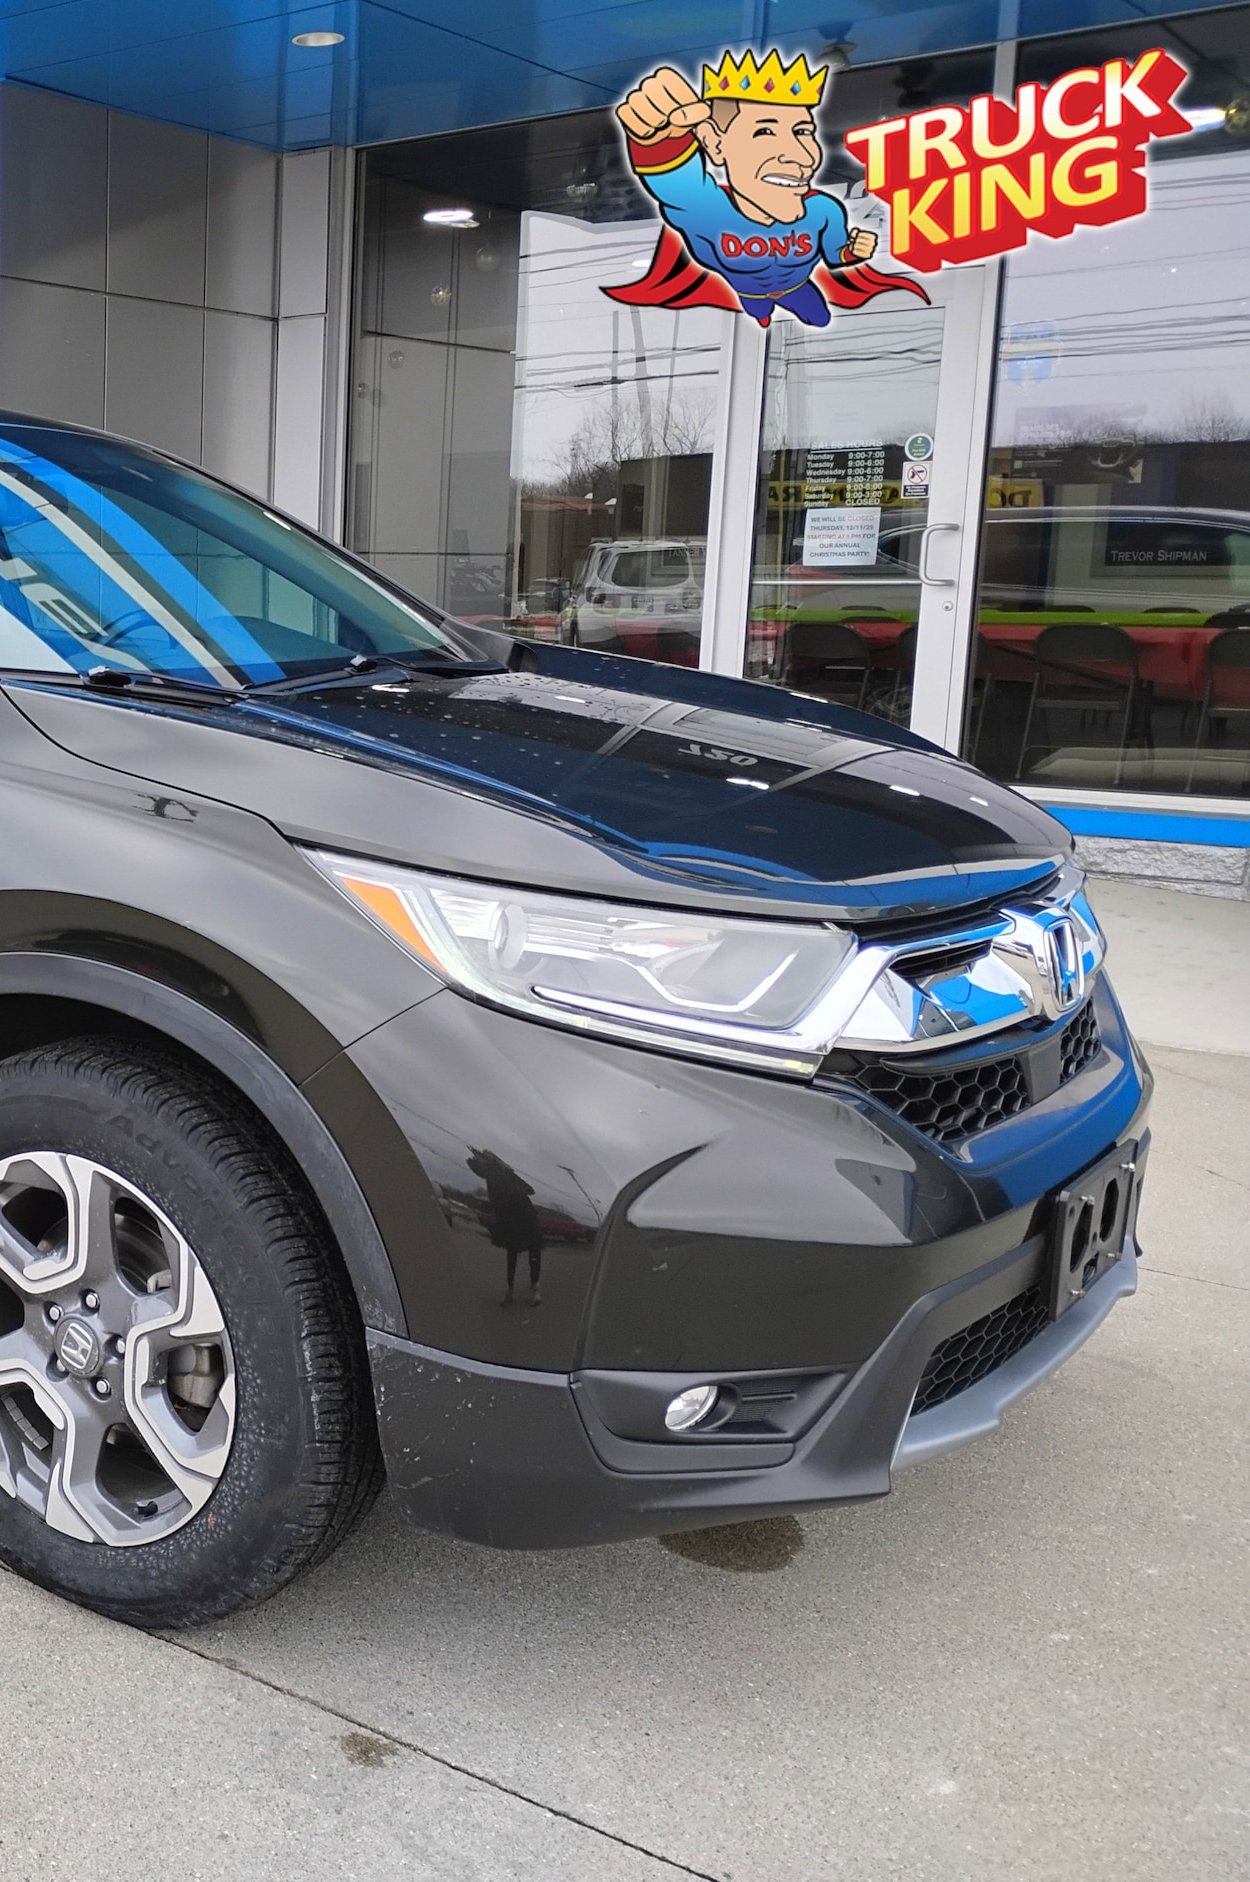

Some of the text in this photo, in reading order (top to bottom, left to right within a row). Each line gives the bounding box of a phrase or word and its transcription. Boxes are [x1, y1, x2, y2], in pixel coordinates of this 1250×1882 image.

[807, 451, 885, 462] Monday 9:00-7:00
[807, 459, 885, 469] Tuesday 9:00-6:00
[806, 467, 884, 477] Wednesday 9:00-6:00
[806, 475, 883, 485] Thursday 9:00-7:00
[805, 483, 883, 493] Friday 9:00-6:00
[804, 491, 882, 501] Saturday 9:00-3:00
[804, 498, 880, 508] Sunday CLOSED
[1111, 550, 1207, 562] TREVOR SHIPMAN
